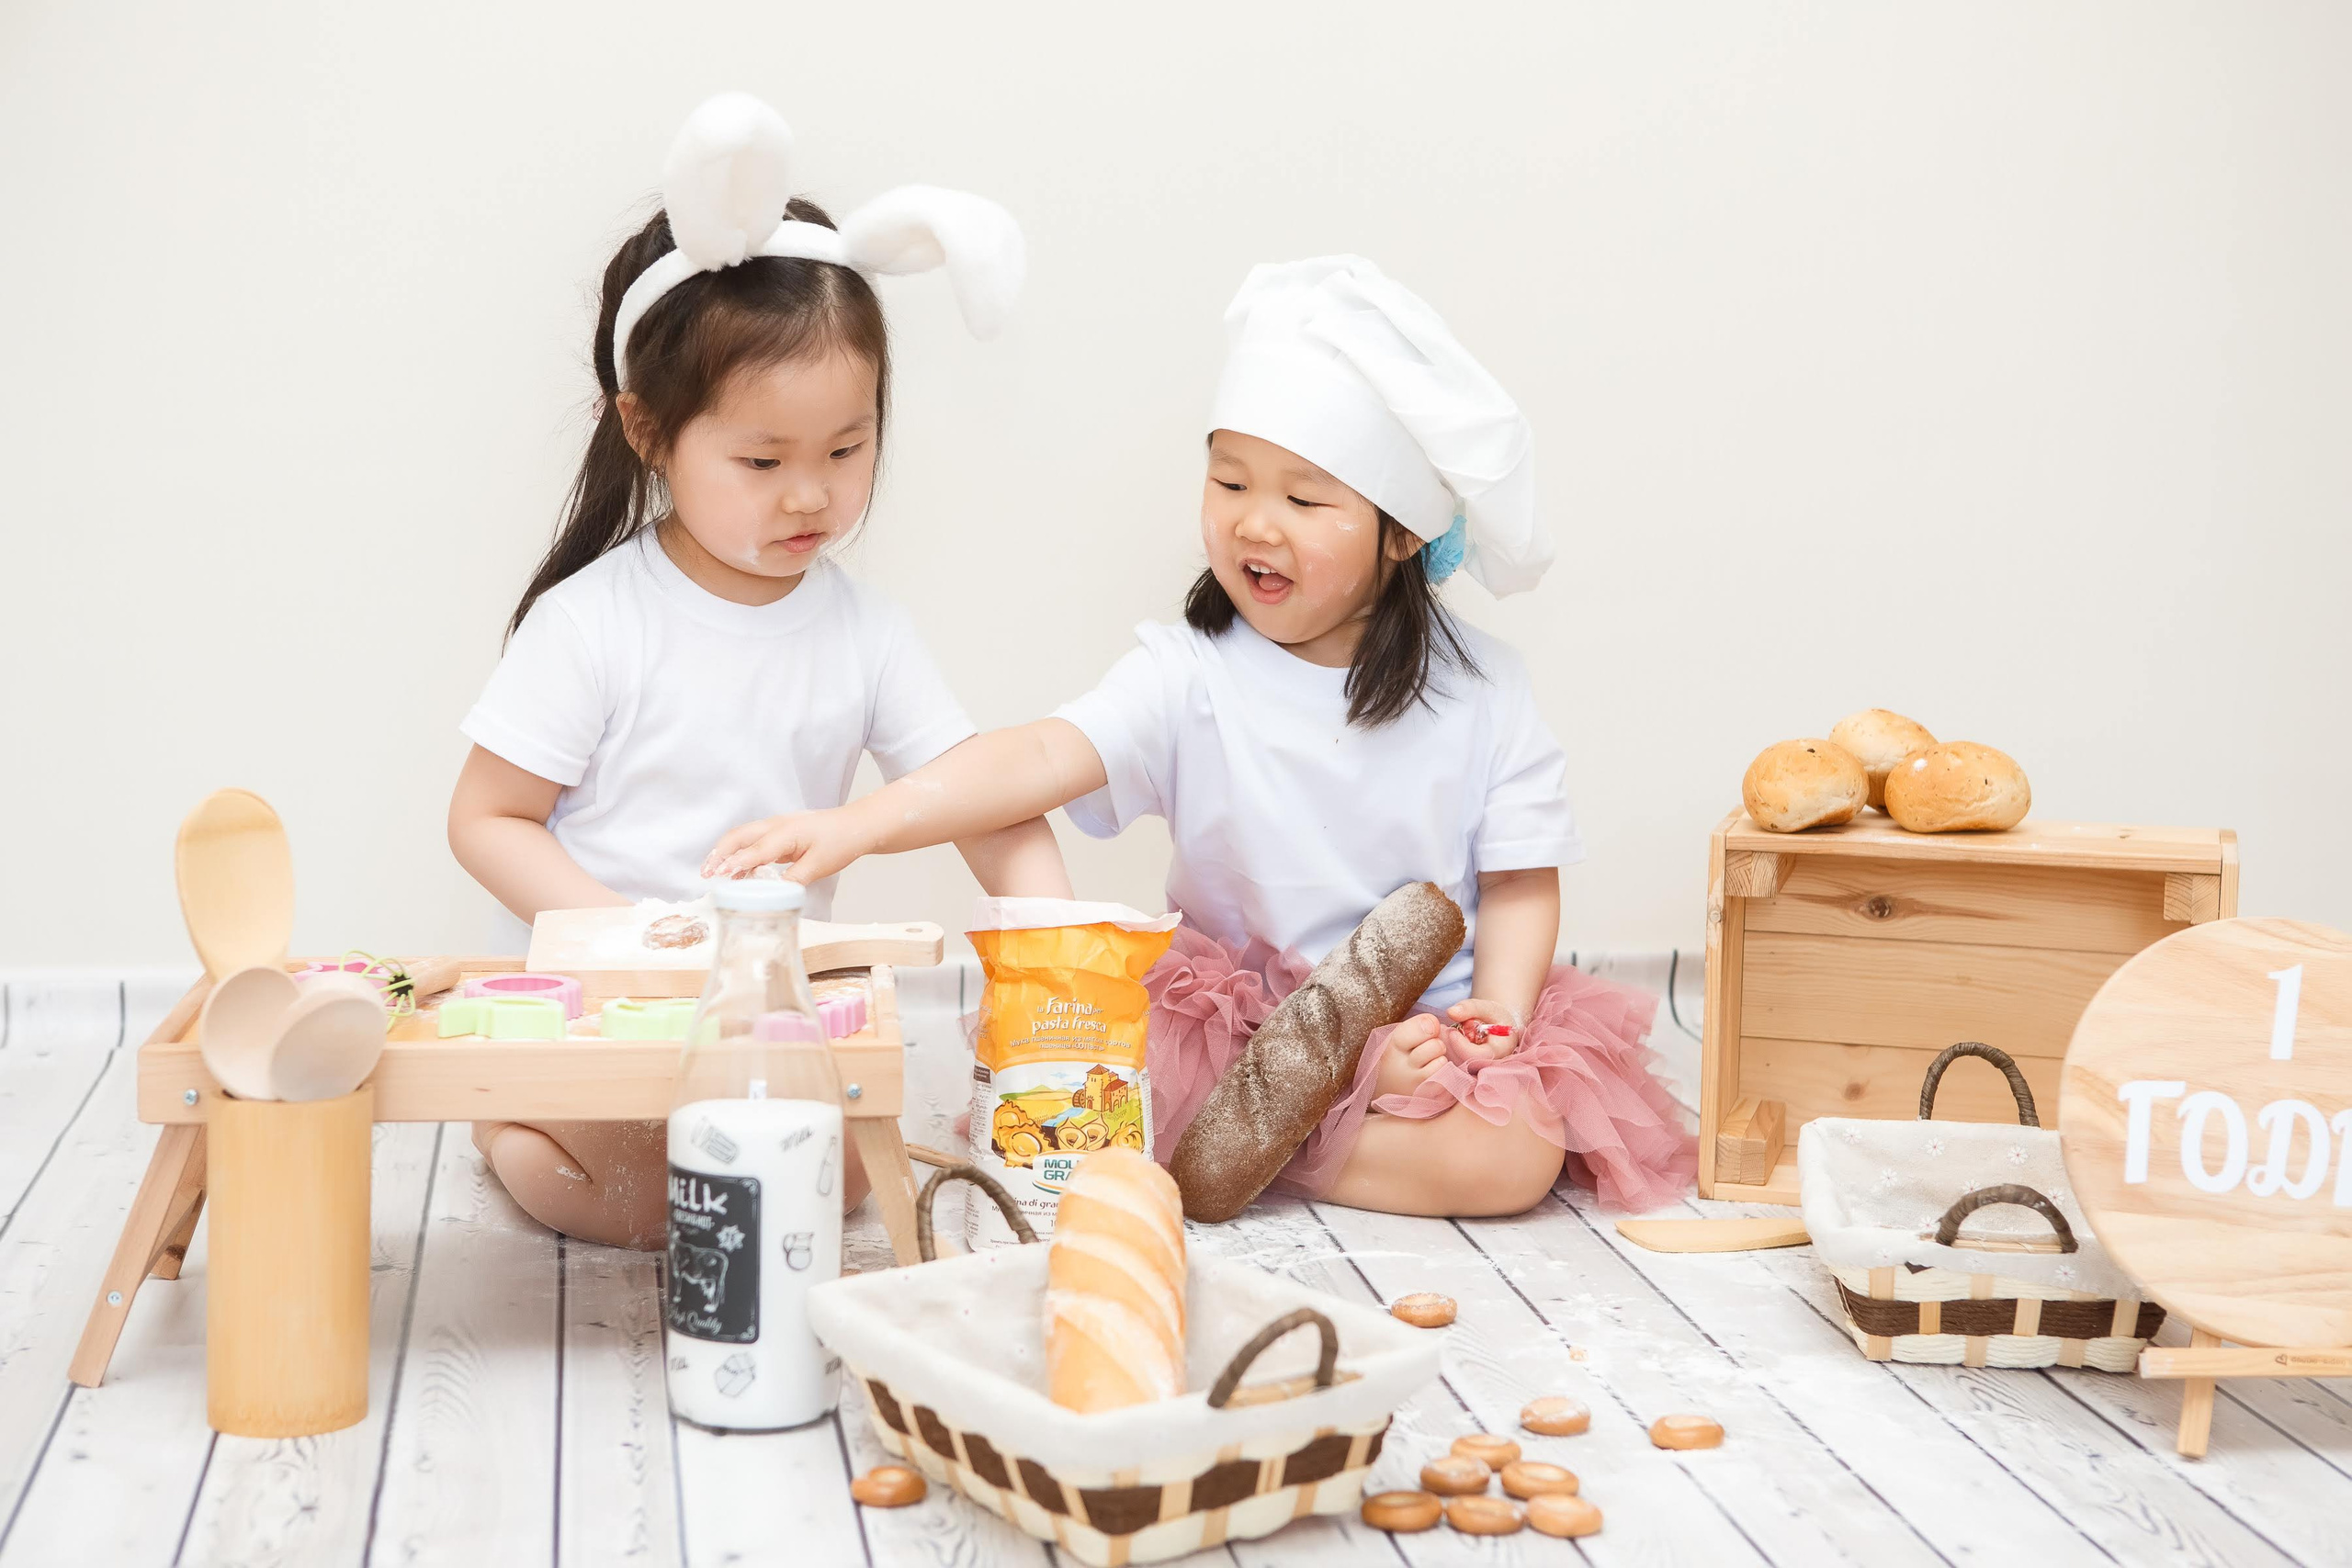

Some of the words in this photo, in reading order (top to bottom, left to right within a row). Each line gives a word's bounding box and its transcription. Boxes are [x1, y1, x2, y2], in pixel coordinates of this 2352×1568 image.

[1046, 997, 1093, 1016] Farina
[2267, 963, 2303, 1060] 1
[1032, 1016, 1069, 1035] pasta
[1071, 1016, 1107, 1033] fresca
[1044, 1158, 1072, 1169] MOL
[1028, 1199, 1038, 1207] di
